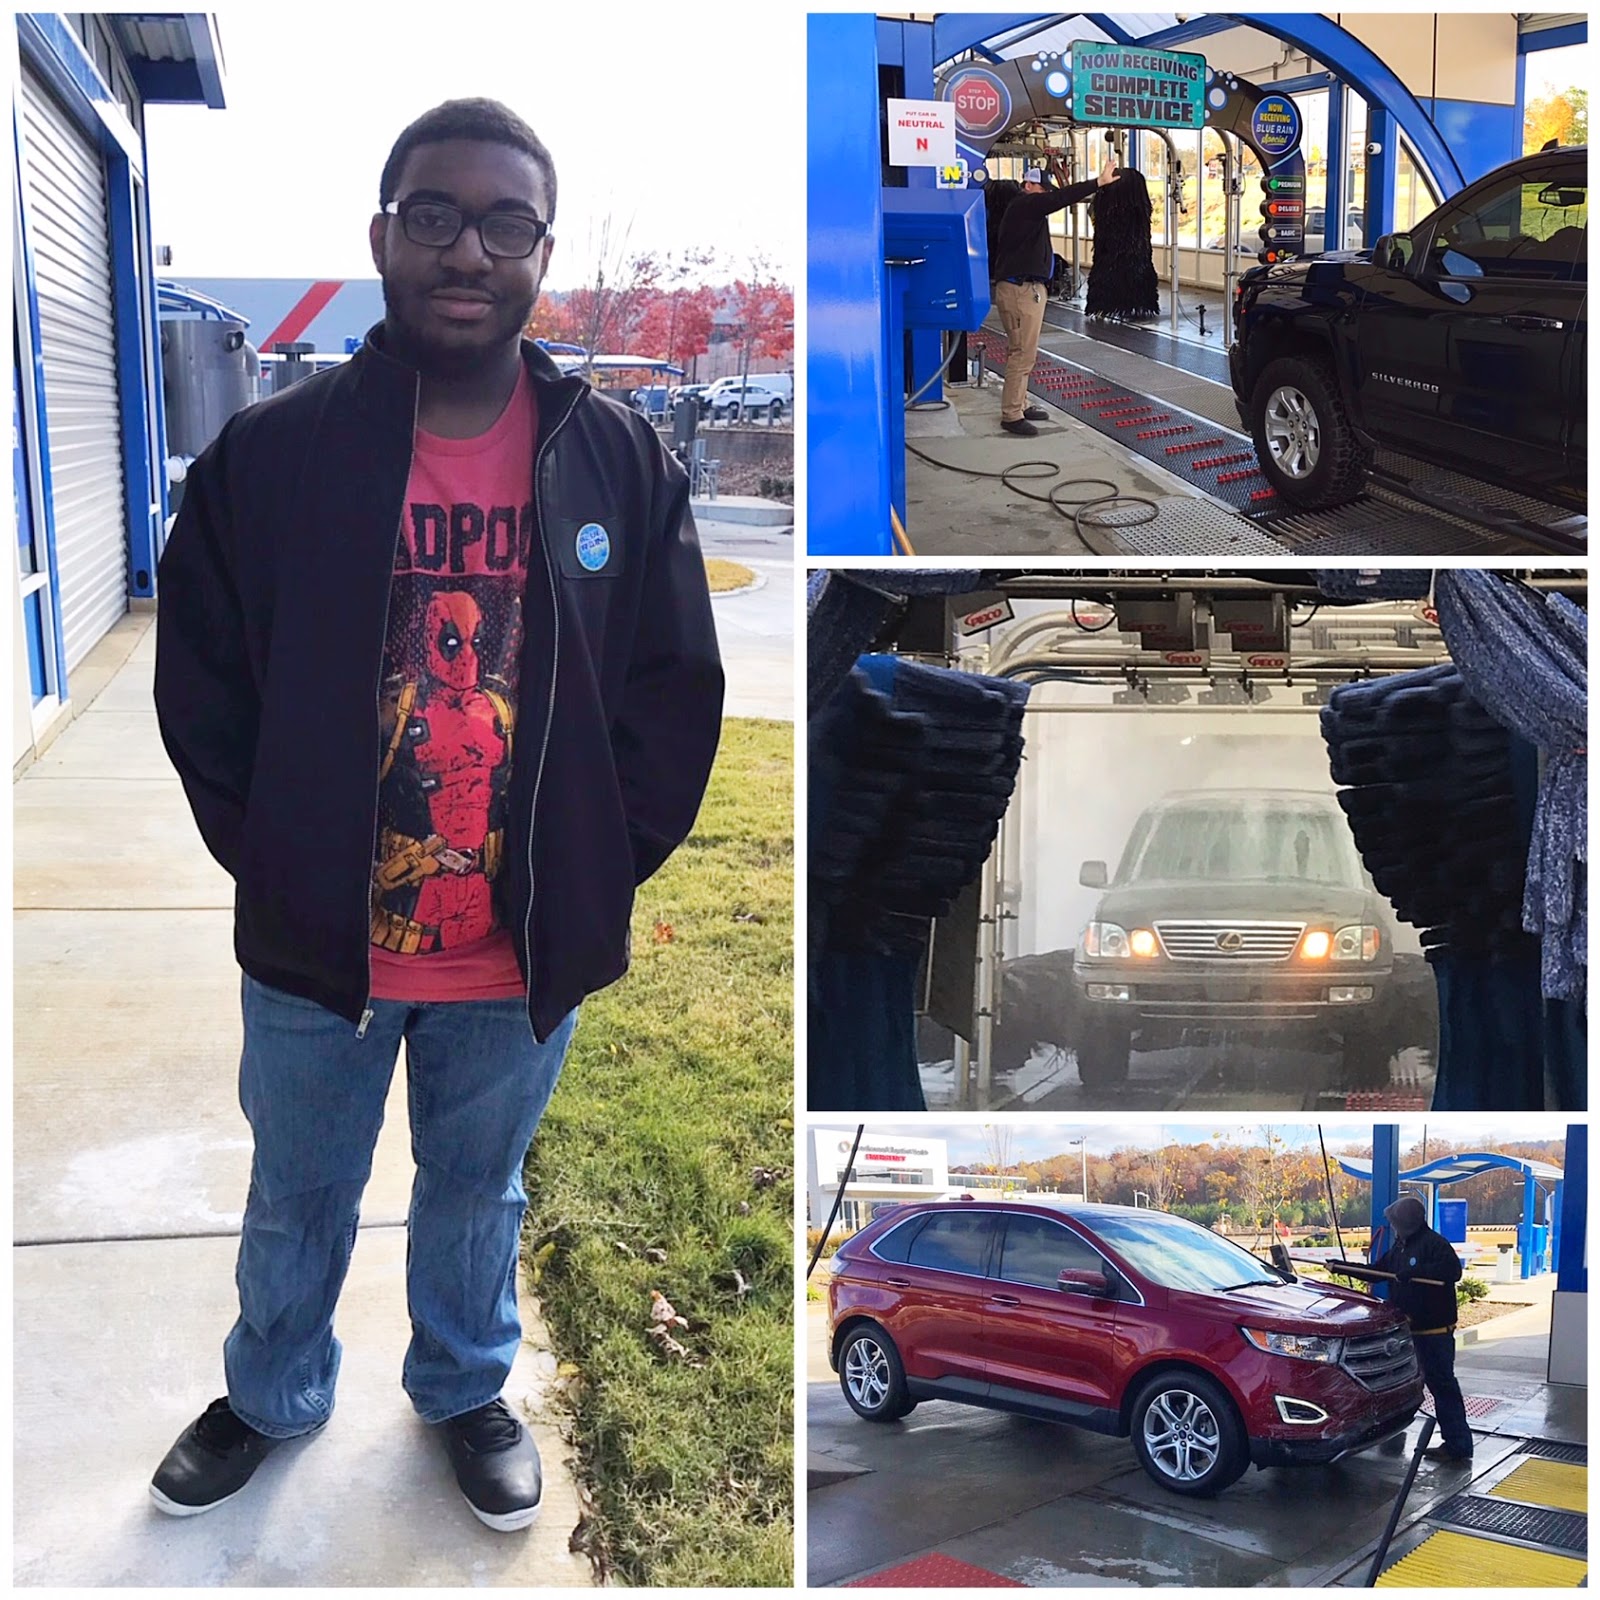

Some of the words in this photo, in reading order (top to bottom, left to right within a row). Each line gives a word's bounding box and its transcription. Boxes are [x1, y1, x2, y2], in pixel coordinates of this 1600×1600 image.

[1081, 53, 1120, 70] NOW
[1123, 53, 1198, 81] RECEIVING
[1091, 72, 1188, 99] COMPLETE
[957, 95, 997, 111] STOP
[1084, 94, 1194, 123] SERVICE
[1268, 103, 1284, 113] NOW
[898, 119, 945, 129] NEUTRAL
[1260, 112, 1291, 124] RECEIVING
[1256, 123, 1276, 134] BLUE
[1276, 125, 1295, 135] RAIN
[916, 138, 928, 151] N
[943, 166, 961, 181] N
[1371, 372, 1439, 394] SILVERADO
[1253, 659, 1285, 667] PECO
[865, 1153, 906, 1162] EMERGENCY
